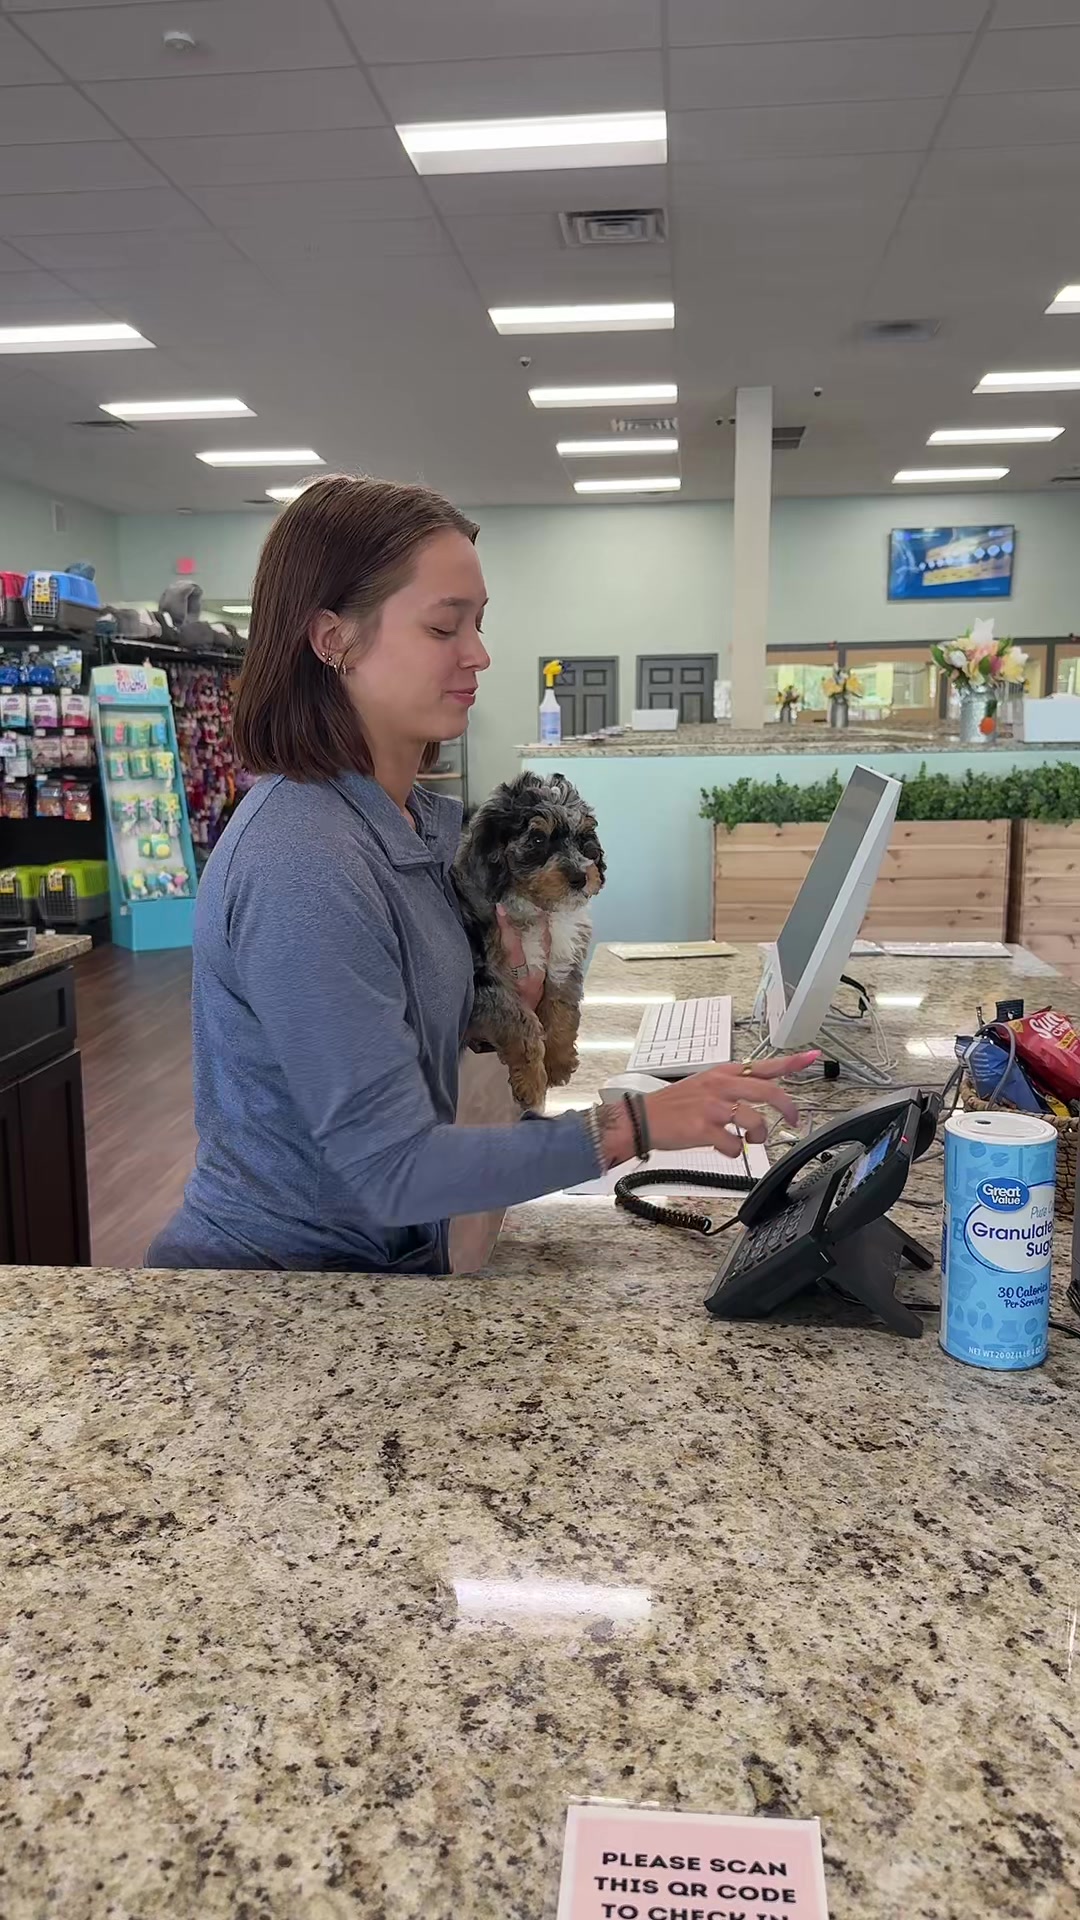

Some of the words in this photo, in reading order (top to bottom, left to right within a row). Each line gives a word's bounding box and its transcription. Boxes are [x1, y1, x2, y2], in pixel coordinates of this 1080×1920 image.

[982, 1183, 1021, 1197] Great
[991, 1196, 1021, 1205] Value
[972, 1219, 1055, 1240] Granulate
[997, 1286, 1014, 1299] 30
[1004, 1299, 1019, 1309] Per
[1019, 1296, 1044, 1309] Serving
[968, 1346, 981, 1356] NET
[995, 1351, 1004, 1359] 20
[602, 1852, 701, 1871] PLEASE
[710, 1858, 788, 1877] SCAN
[594, 1876, 659, 1894] THIS
[668, 1882, 708, 1898] QR
[717, 1885, 797, 1904] CODE
[601, 1903, 639, 1920] TO
[648, 1906, 746, 1920] CHECK
